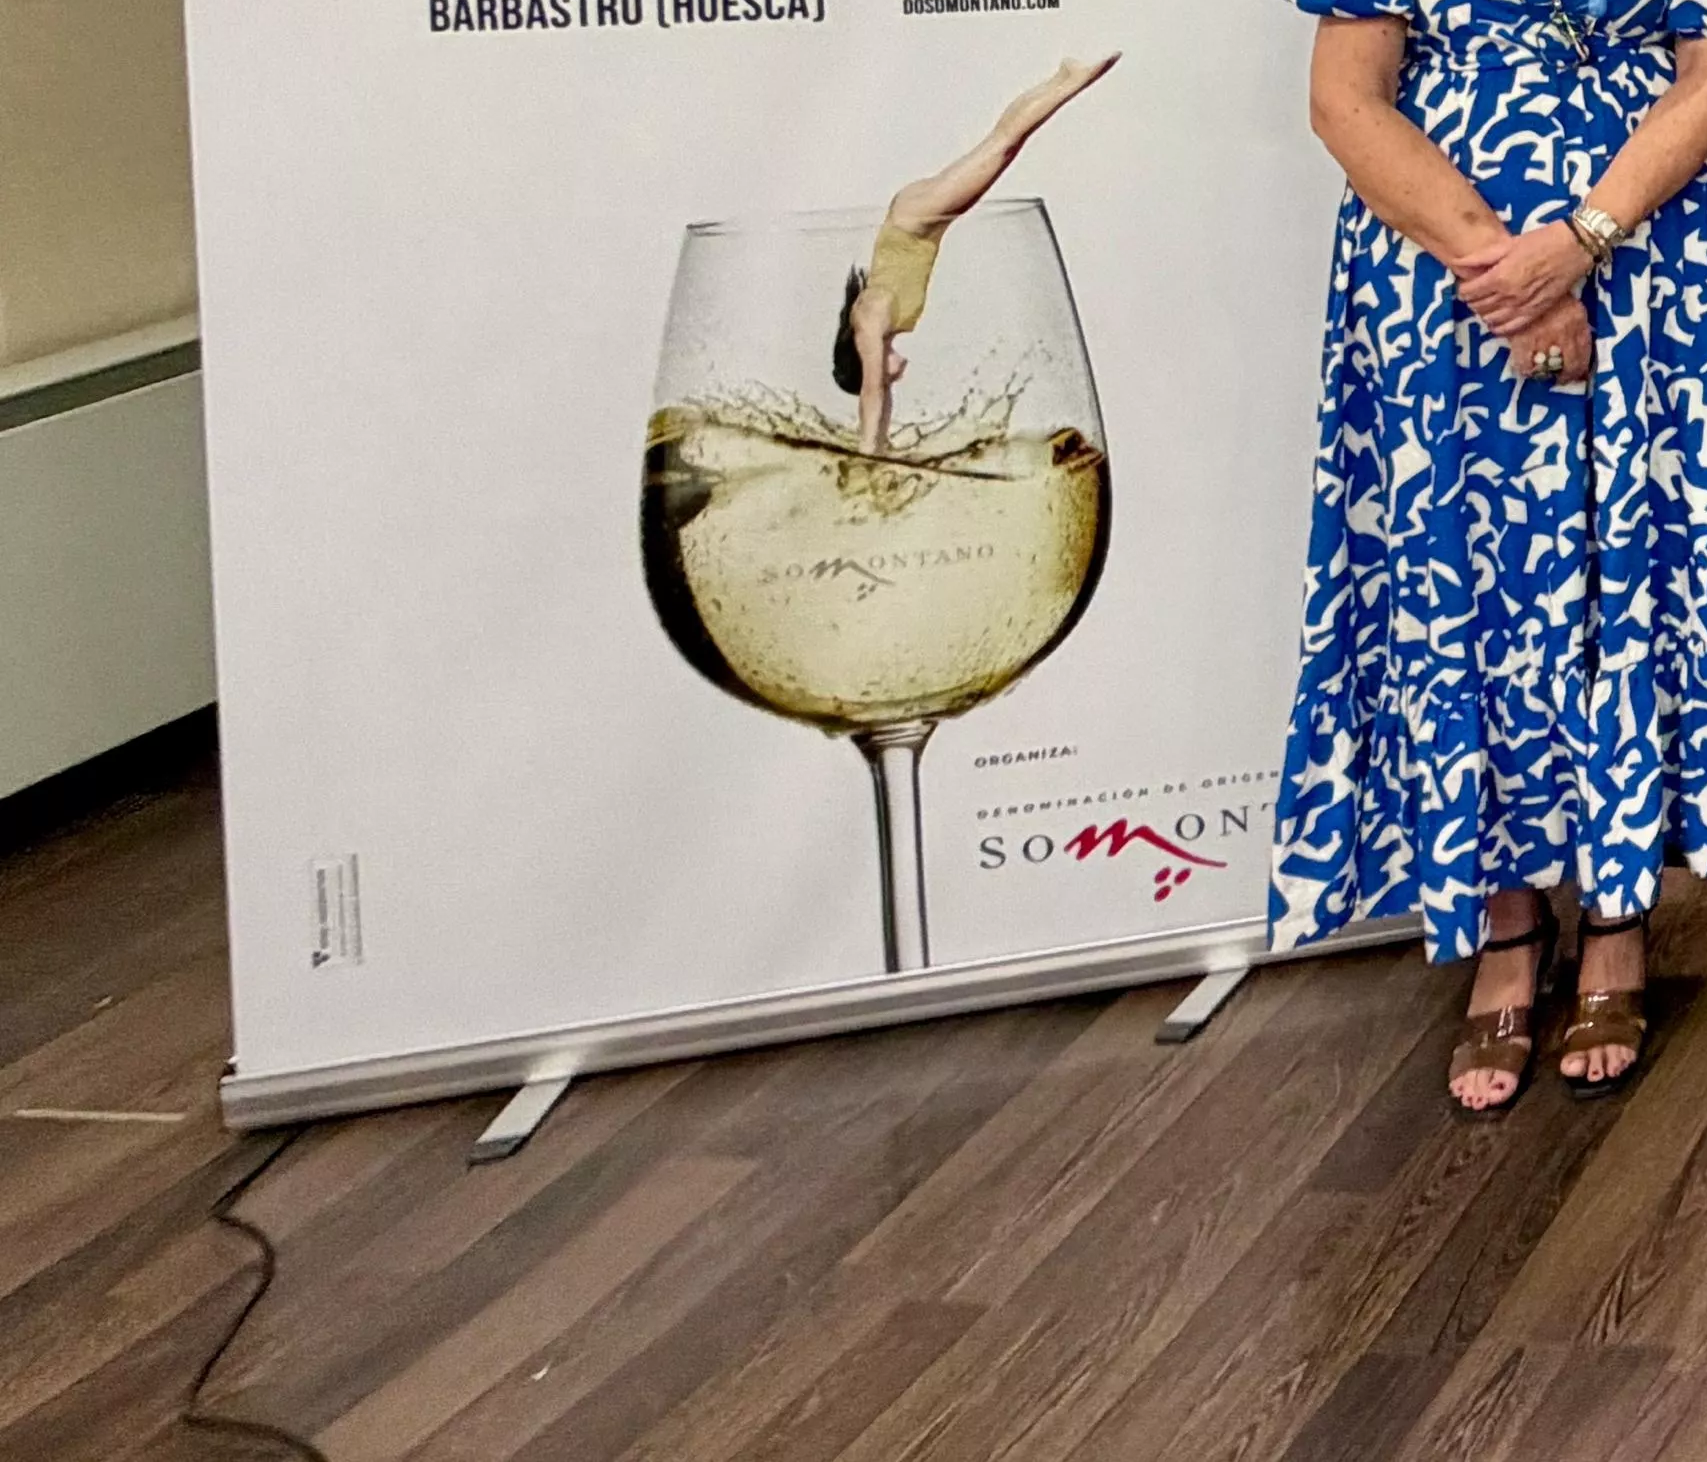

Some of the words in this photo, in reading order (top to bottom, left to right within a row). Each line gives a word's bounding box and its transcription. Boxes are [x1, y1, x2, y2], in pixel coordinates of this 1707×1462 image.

[759, 544, 995, 586] SOMONTANO
[974, 745, 1079, 769] ORGANIZA:
[976, 787, 1150, 820] DENOMINACIÓN
[1163, 781, 1187, 794] DE
[1201, 769, 1280, 789] ORIGEN
[978, 802, 1275, 870] SOMON
